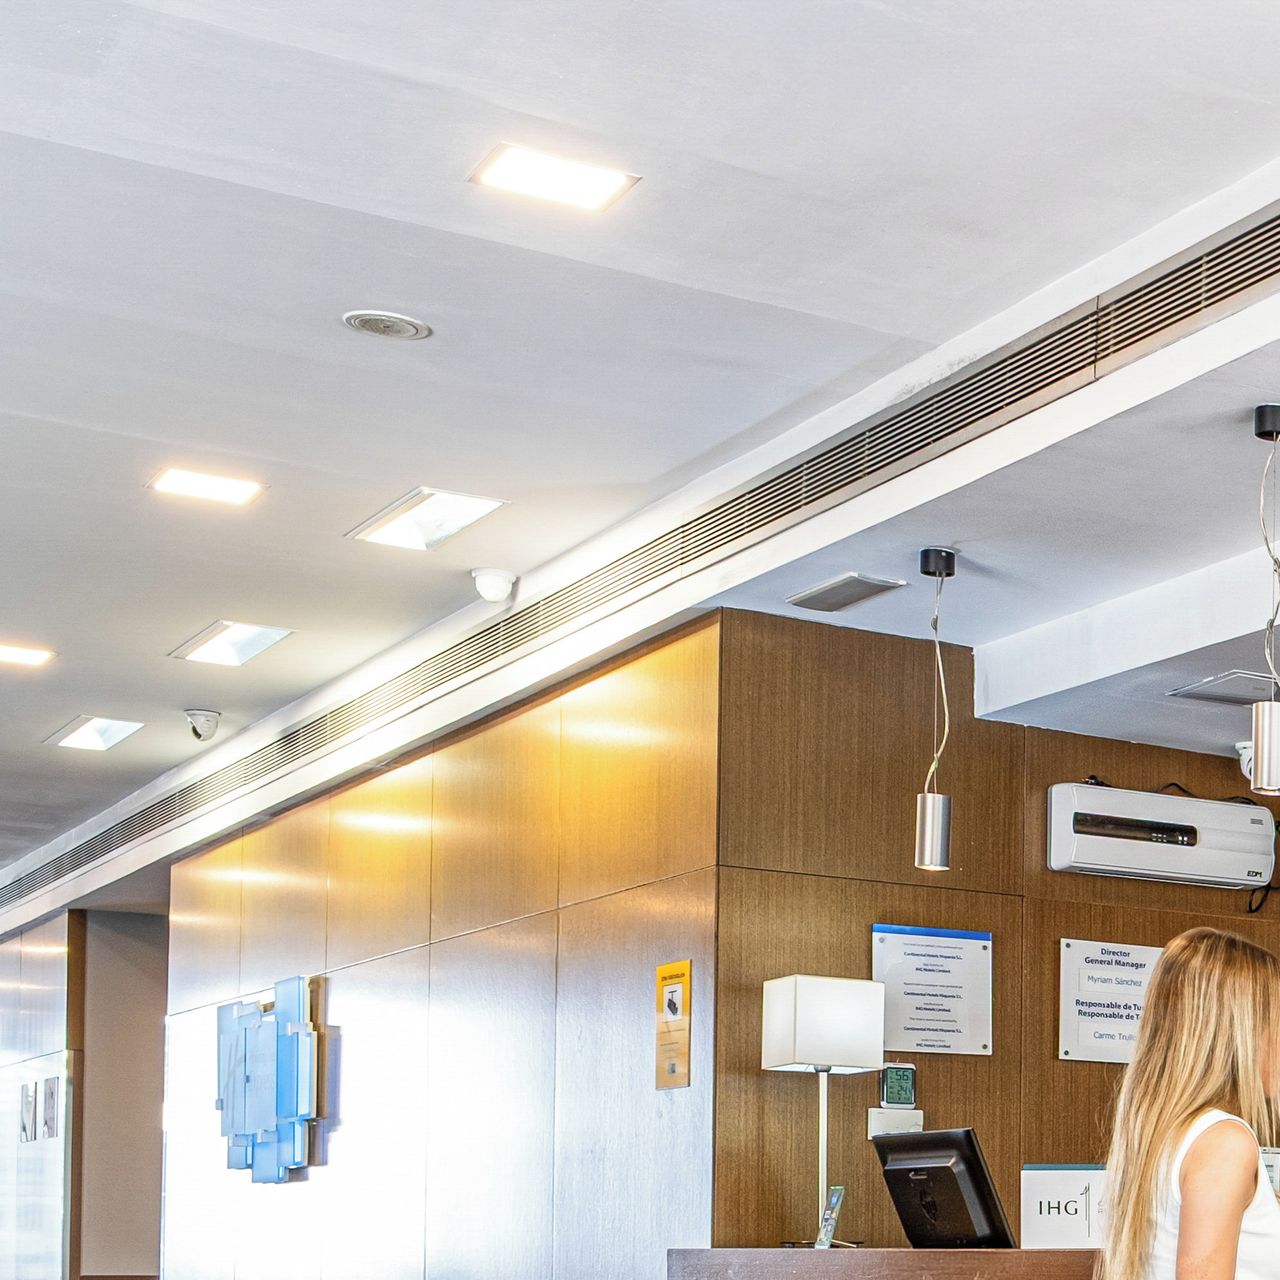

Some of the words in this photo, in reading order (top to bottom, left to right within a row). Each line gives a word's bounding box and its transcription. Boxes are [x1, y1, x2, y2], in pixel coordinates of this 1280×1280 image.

[1246, 870, 1263, 879] EDM
[1101, 948, 1131, 958] Director
[1084, 957, 1113, 966] General
[1114, 960, 1147, 970] Manager
[1087, 975, 1113, 985] Myriam
[1114, 977, 1143, 987] Sánchez
[1075, 999, 1122, 1010] Responsable
[1123, 1003, 1132, 1011] de
[1133, 1003, 1142, 1011] Tu
[1078, 1010, 1123, 1020] Responsable
[1093, 1031, 1116, 1040] Carme
[1039, 1200, 1078, 1216] IHG
